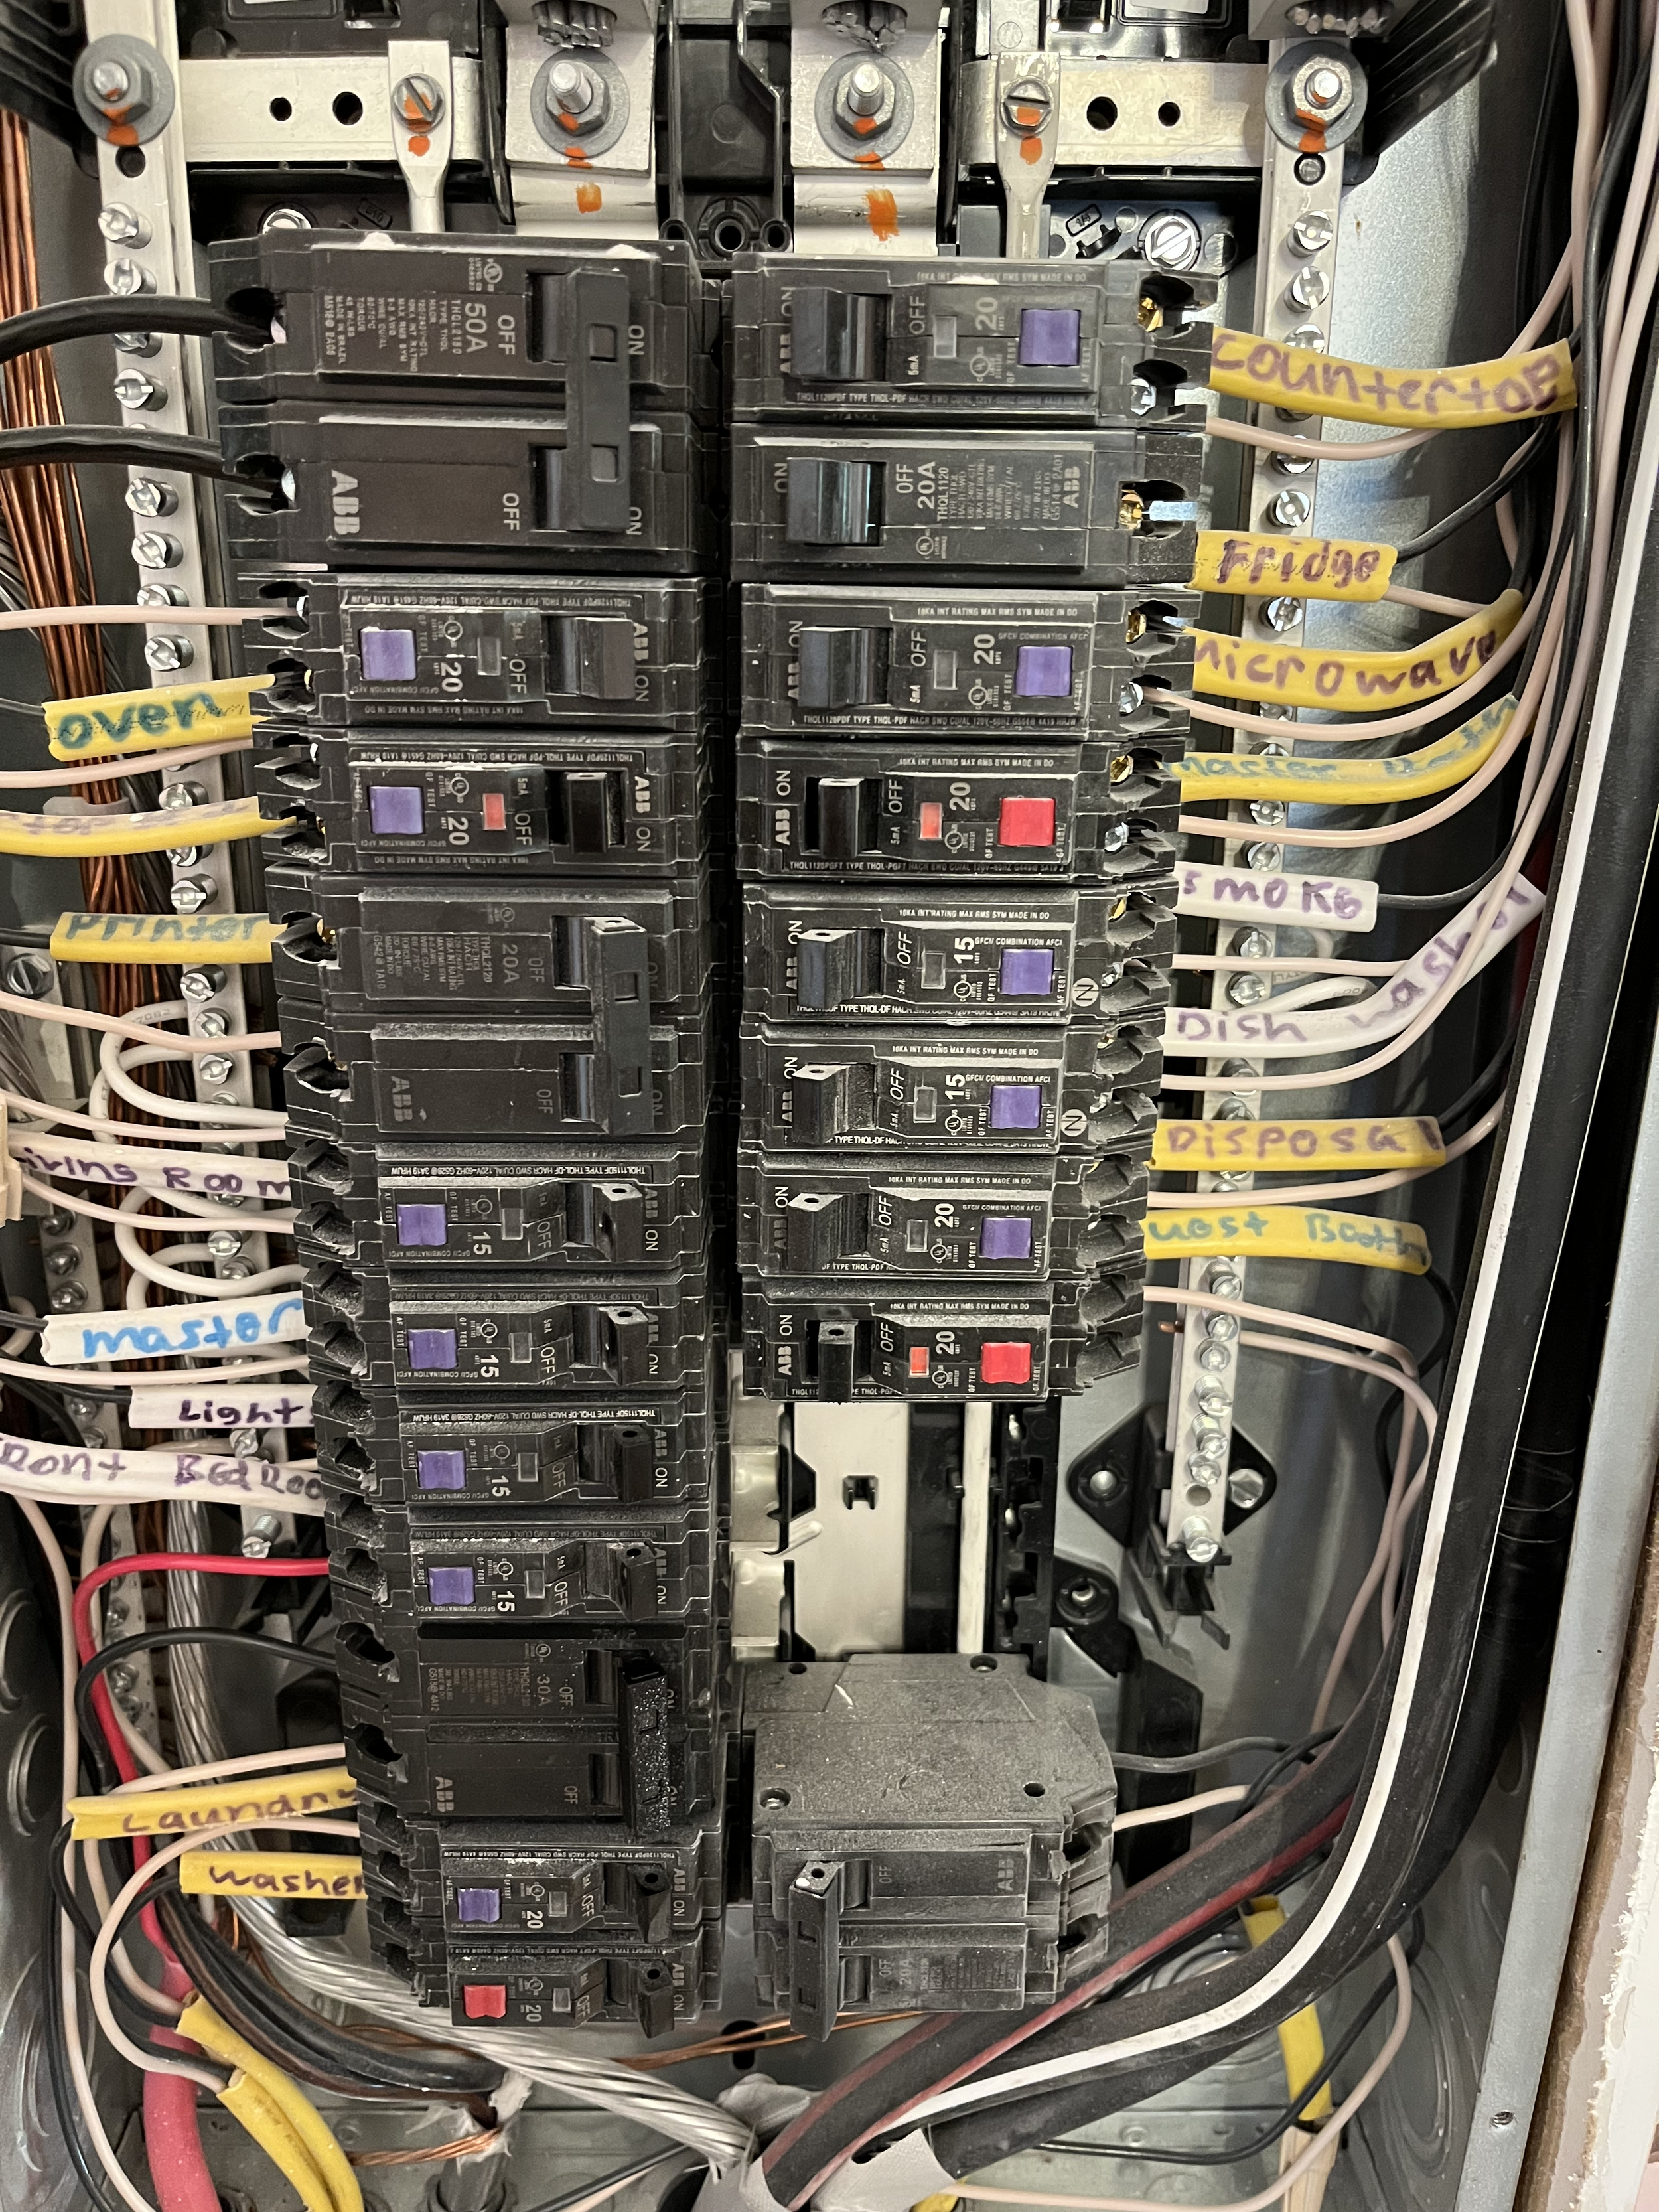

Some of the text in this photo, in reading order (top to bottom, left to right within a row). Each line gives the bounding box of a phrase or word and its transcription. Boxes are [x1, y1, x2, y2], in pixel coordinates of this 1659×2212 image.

[781, 288, 793, 317] ON
[908, 295, 925, 335] OFF
[975, 297, 998, 332] 20
[466, 303, 488, 353] 50A
[498, 315, 516, 356] OFF
[629, 325, 644, 357] ON
[780, 333, 792, 373] ABB
[774, 462, 789, 494] ON
[896, 463, 914, 494] OFF
[918, 461, 936, 510] 20A
[1062, 466, 1081, 509] ABB
[332, 469, 360, 535] ABB
[502, 492, 520, 531] OFF
[628, 506, 642, 536] ON
[1217, 539, 1380, 588] Fridge
[634, 623, 649, 662] ABB
[788, 621, 804, 648] ON
[910, 630, 927, 668] OFF
[973, 633, 995, 665] 20
[441, 662, 463, 692] 20
[509, 658, 527, 694] OFF
[635, 675, 650, 702] ON
[788, 662, 800, 701] ABB
[853, 715, 872, 725] TYPE
[566, 753, 584, 762] TYPE
[634, 776, 651, 814] ABB
[776, 770, 791, 797] ON
[888, 779, 904, 814] OFF
[949, 782, 972, 812] 20
[447, 816, 470, 846] 20
[514, 812, 532, 846] OFF
[636, 826, 651, 851] ON
[775, 808, 791, 846] ABB
[890, 826, 901, 846] 5mA
[845, 861, 865, 871] TYPE
[788, 921, 803, 945] ON
[996, 937, 1063, 947] COMBINATION AFCI
[897, 930, 912, 965] OFF
[953, 936, 975, 964] 15
[502, 943, 521, 984] 20A
[528, 958, 545, 983] OFF
[648, 961, 659, 988] ON
[786, 956, 798, 990] ABB
[897, 978, 906, 995] 5mA
[987, 972, 997, 993] TEST
[1056, 974, 1066, 994] TEST
[840, 1005, 859, 1013] TYPE
[784, 1057, 798, 1080] ON
[889, 1067, 904, 1100] OFF
[944, 1074, 966, 1100] 15
[390, 1076, 413, 1122] ABB
[536, 1089, 553, 1115] OFF
[652, 1090, 664, 1116] ON
[782, 1090, 793, 1122] ABB
[978, 1108, 987, 1128] TEST
[1046, 1110, 1054, 1128] TEST
[835, 1136, 853, 1144] TYPE
[644, 1187, 659, 1218] ABB
[775, 1186, 789, 1209] ON
[878, 1195, 893, 1226] OFF
[385, 1206, 394, 1223] TEST
[934, 1203, 954, 1228] 20
[1149, 1211, 1268, 1241] uest
[472, 1232, 492, 1256] 15
[536, 1221, 552, 1248] OFF
[645, 1229, 659, 1251] ON
[773, 1218, 787, 1250] ABB
[879, 1238, 889, 1254] 5mA
[83, 1298, 303, 1359] master
[646, 1313, 659, 1343] ABB
[779, 1315, 793, 1336] ON
[880, 1321, 894, 1353] OFF
[935, 1331, 955, 1355] 20
[480, 1354, 500, 1378] 15
[540, 1346, 556, 1375] OFF
[648, 1353, 658, 1375] ON
[778, 1345, 792, 1376] ABB
[882, 1361, 891, 1377] 5mA
[177, 1398, 304, 1426] Light
[654, 1428, 668, 1457] ABB
[491, 1475, 510, 1497] 15
[551, 1461, 567, 1487] OFF
[654, 1467, 669, 1487] ON
[653, 1547, 667, 1576] ABB
[497, 1590, 516, 1613] 15
[554, 1581, 568, 1605] OFF
[656, 1585, 666, 1605] ON
[536, 1676, 551, 1706] 30A
[559, 1686, 574, 1707] OFF
[435, 1776, 455, 1813] ABB
[564, 1785, 579, 1805] OFF
[672, 1868, 686, 1891] ABB
[879, 1864, 893, 1884] OFF
[997, 1858, 1014, 1891] ABB
[581, 1894, 595, 1917] OFF
[672, 1899, 685, 1917] ON
[526, 1910, 544, 1929] 20
[672, 1962, 685, 1986] ABB
[879, 1958, 892, 1978] OFF
[899, 1958, 912, 1986] 20A
[526, 2004, 542, 2022] 20
[577, 1994, 591, 2018] OFF
[672, 1994, 685, 2012] ON
